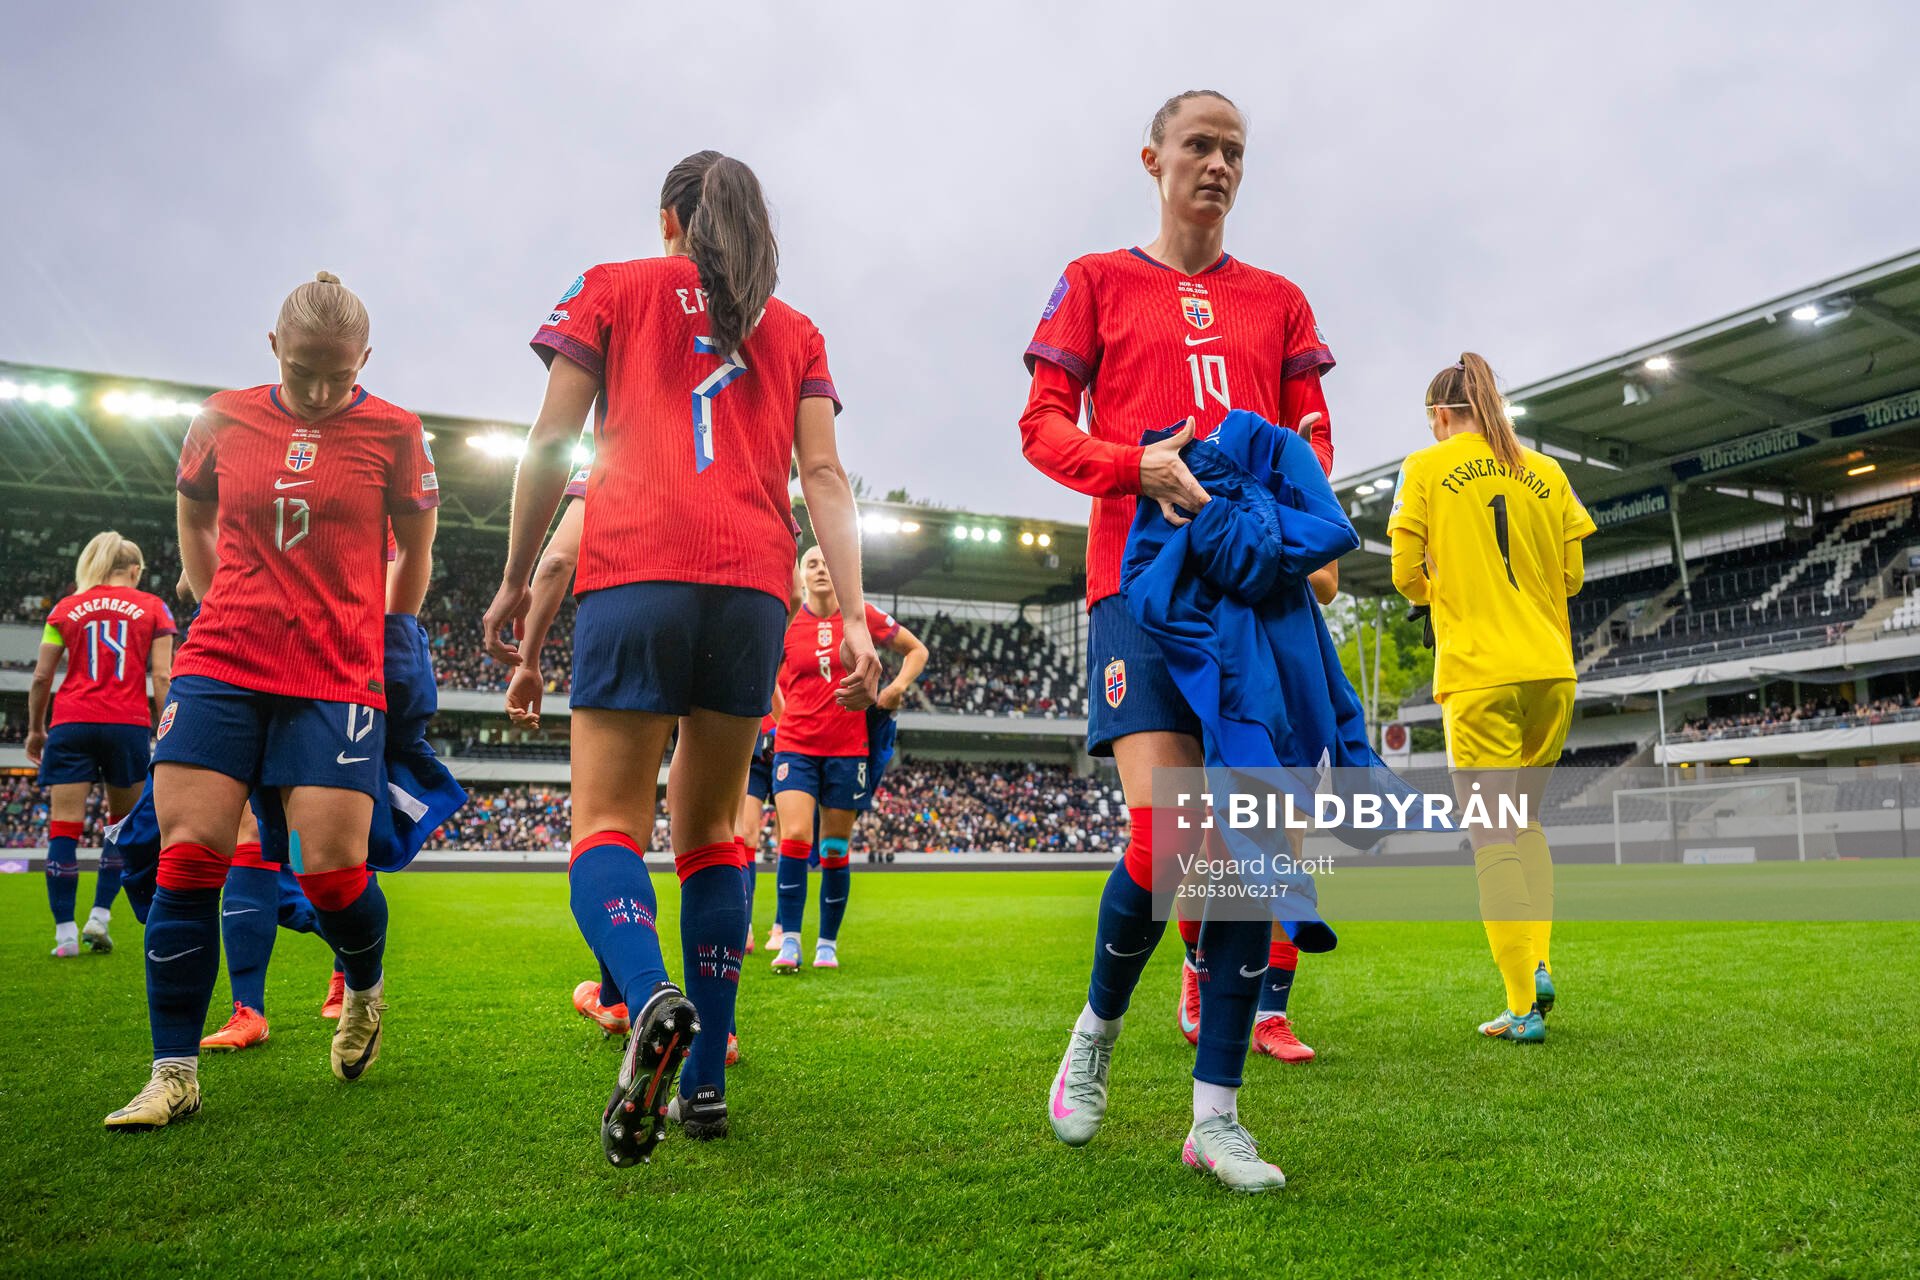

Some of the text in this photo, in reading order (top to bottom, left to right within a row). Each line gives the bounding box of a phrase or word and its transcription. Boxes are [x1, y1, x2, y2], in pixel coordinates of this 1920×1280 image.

[692, 335, 748, 474] 7
[1185, 353, 1231, 411] 10
[272, 497, 311, 552] 13
[1487, 494, 1520, 593] 1
[67, 597, 145, 622] HEGERBERG
[83, 620, 128, 682] 14
[818, 656, 832, 683] 8
[857, 762, 867, 789] 8
[697, 1090, 715, 1099] KING
